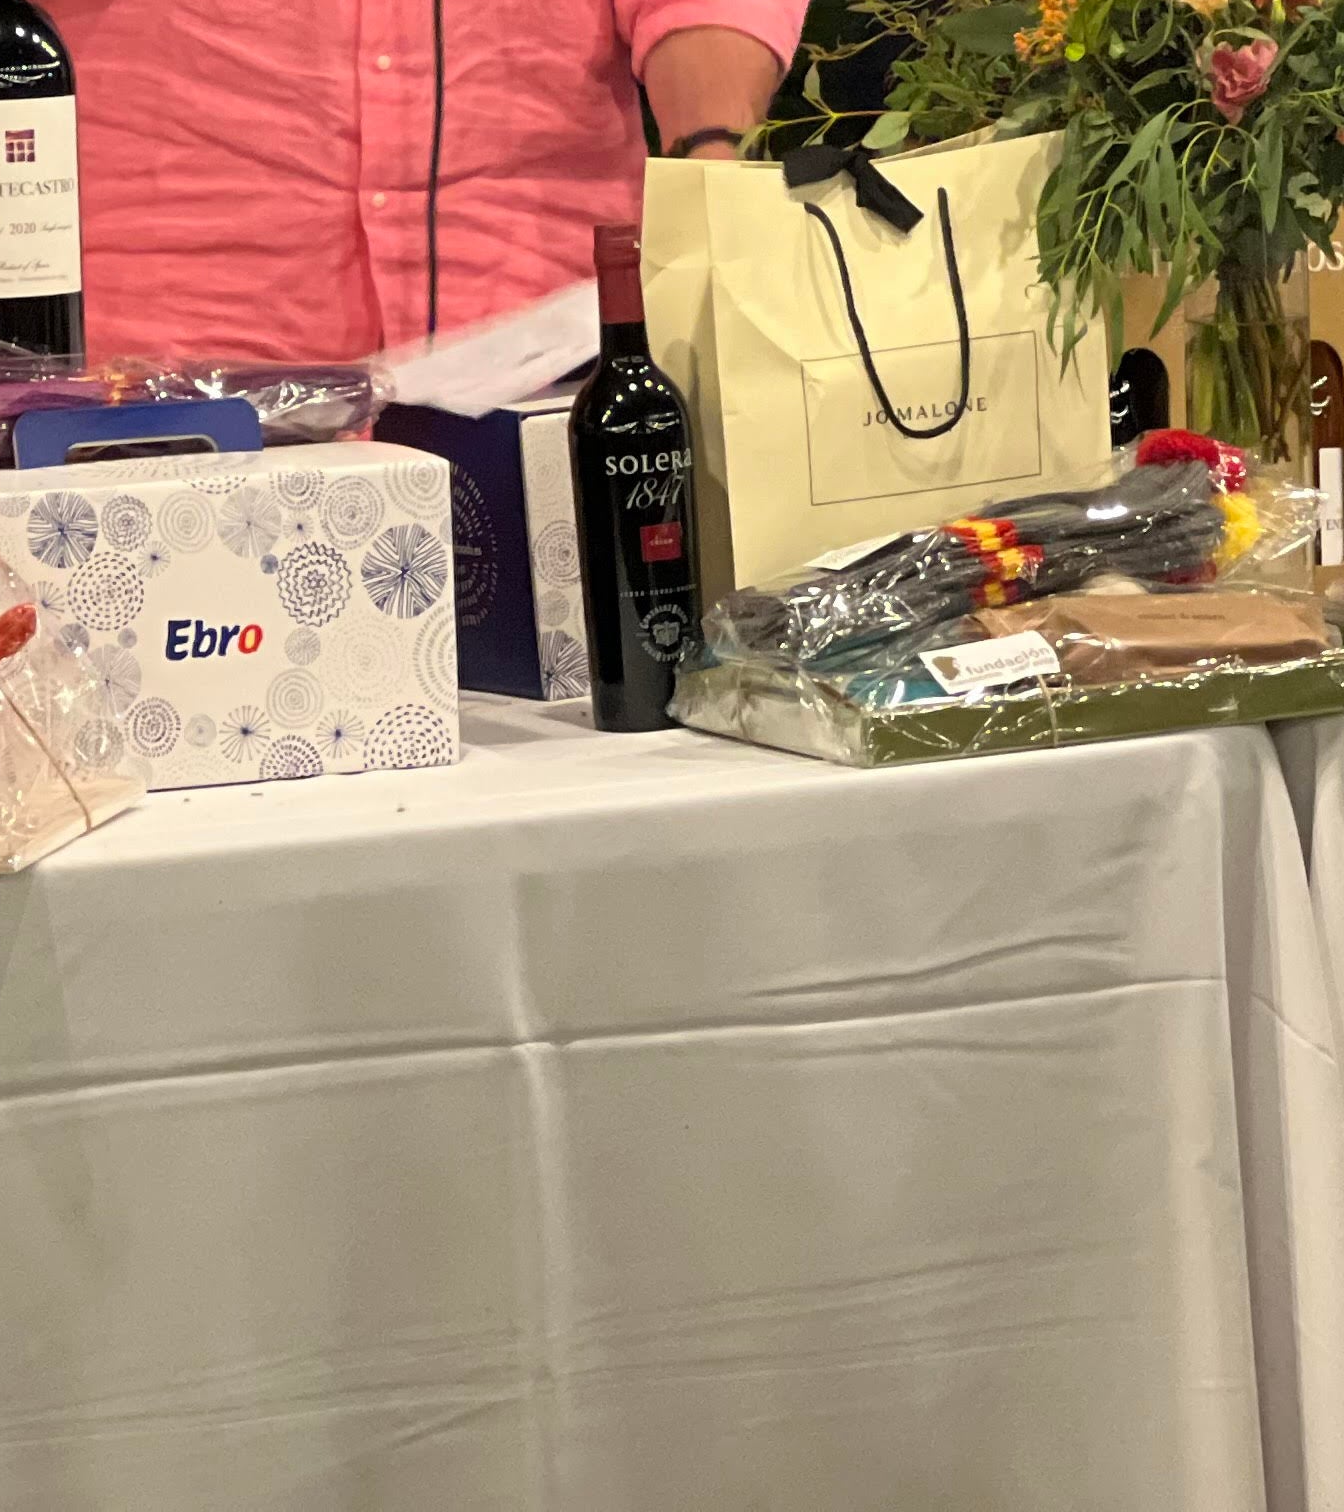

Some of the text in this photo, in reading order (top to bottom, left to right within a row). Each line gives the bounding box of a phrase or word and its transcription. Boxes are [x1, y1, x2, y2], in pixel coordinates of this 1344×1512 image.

[9, 222, 37, 235] 2020
[863, 396, 988, 427] JO MALONE
[625, 475, 685, 510] 1847
[165, 619, 264, 662] Ebro
